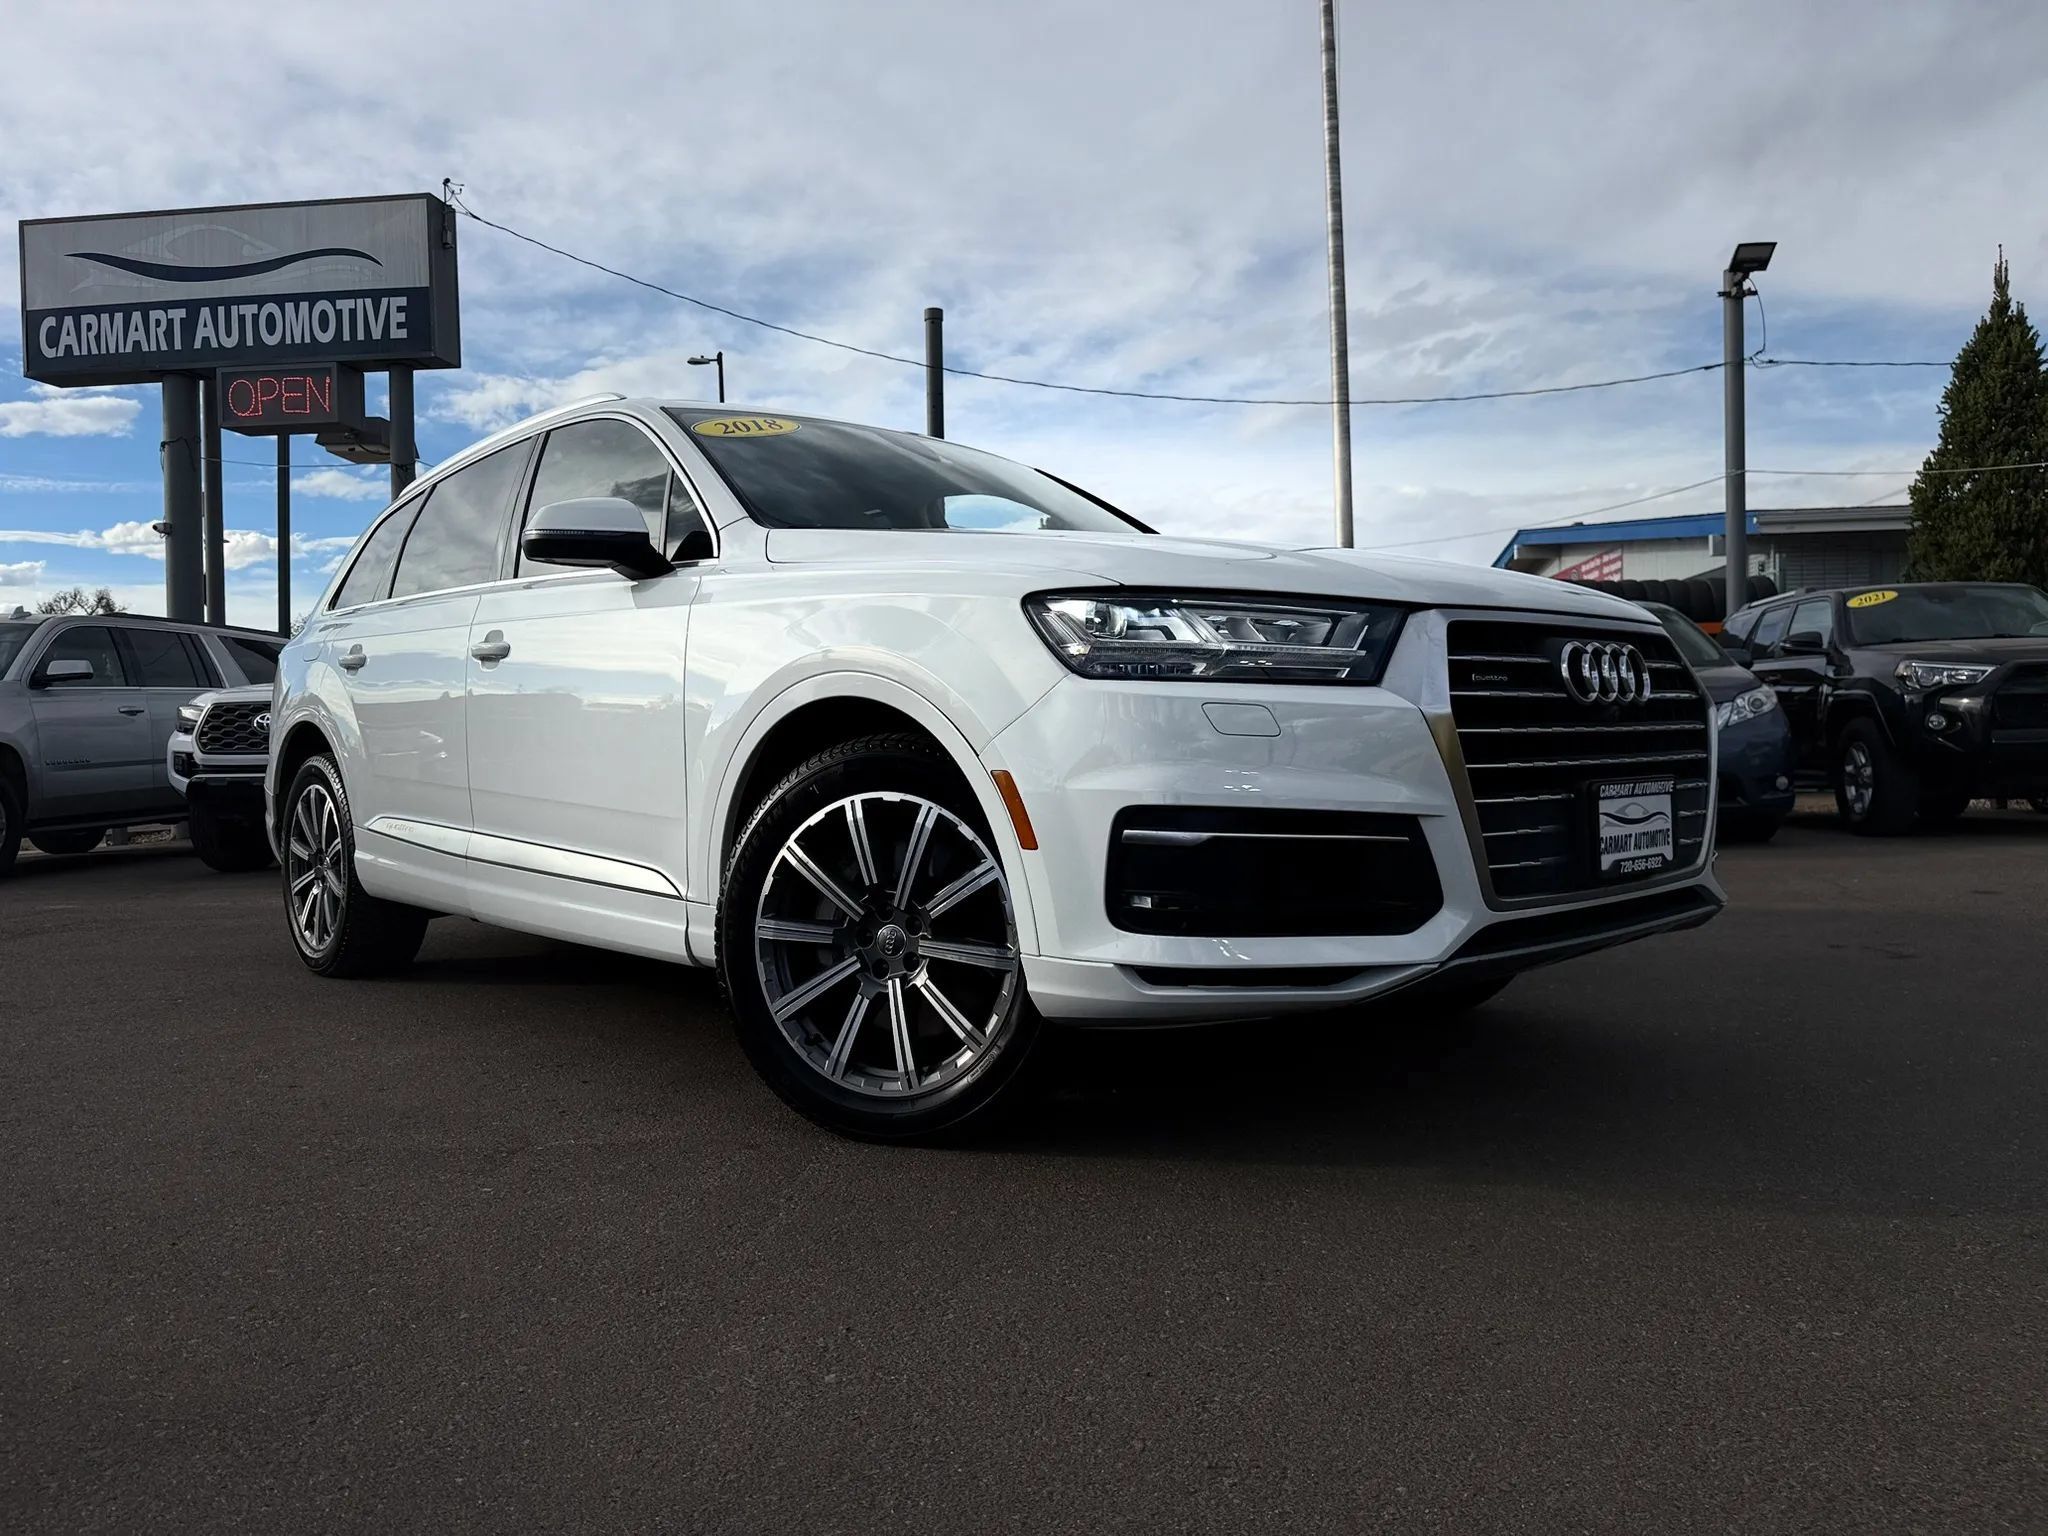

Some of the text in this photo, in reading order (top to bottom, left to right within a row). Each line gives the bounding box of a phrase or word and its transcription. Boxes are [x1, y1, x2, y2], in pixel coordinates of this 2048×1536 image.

[39, 296, 408, 359] CARMART AUTOMOTIVE
[228, 376, 332, 417] OPEN
[714, 419, 783, 435] 2018
[1857, 592, 1886, 606] 2021
[1600, 781, 1675, 798] CARMART AUTOMOTIVE
[1600, 828, 1671, 855] CARMART AUTOMOTIVE
